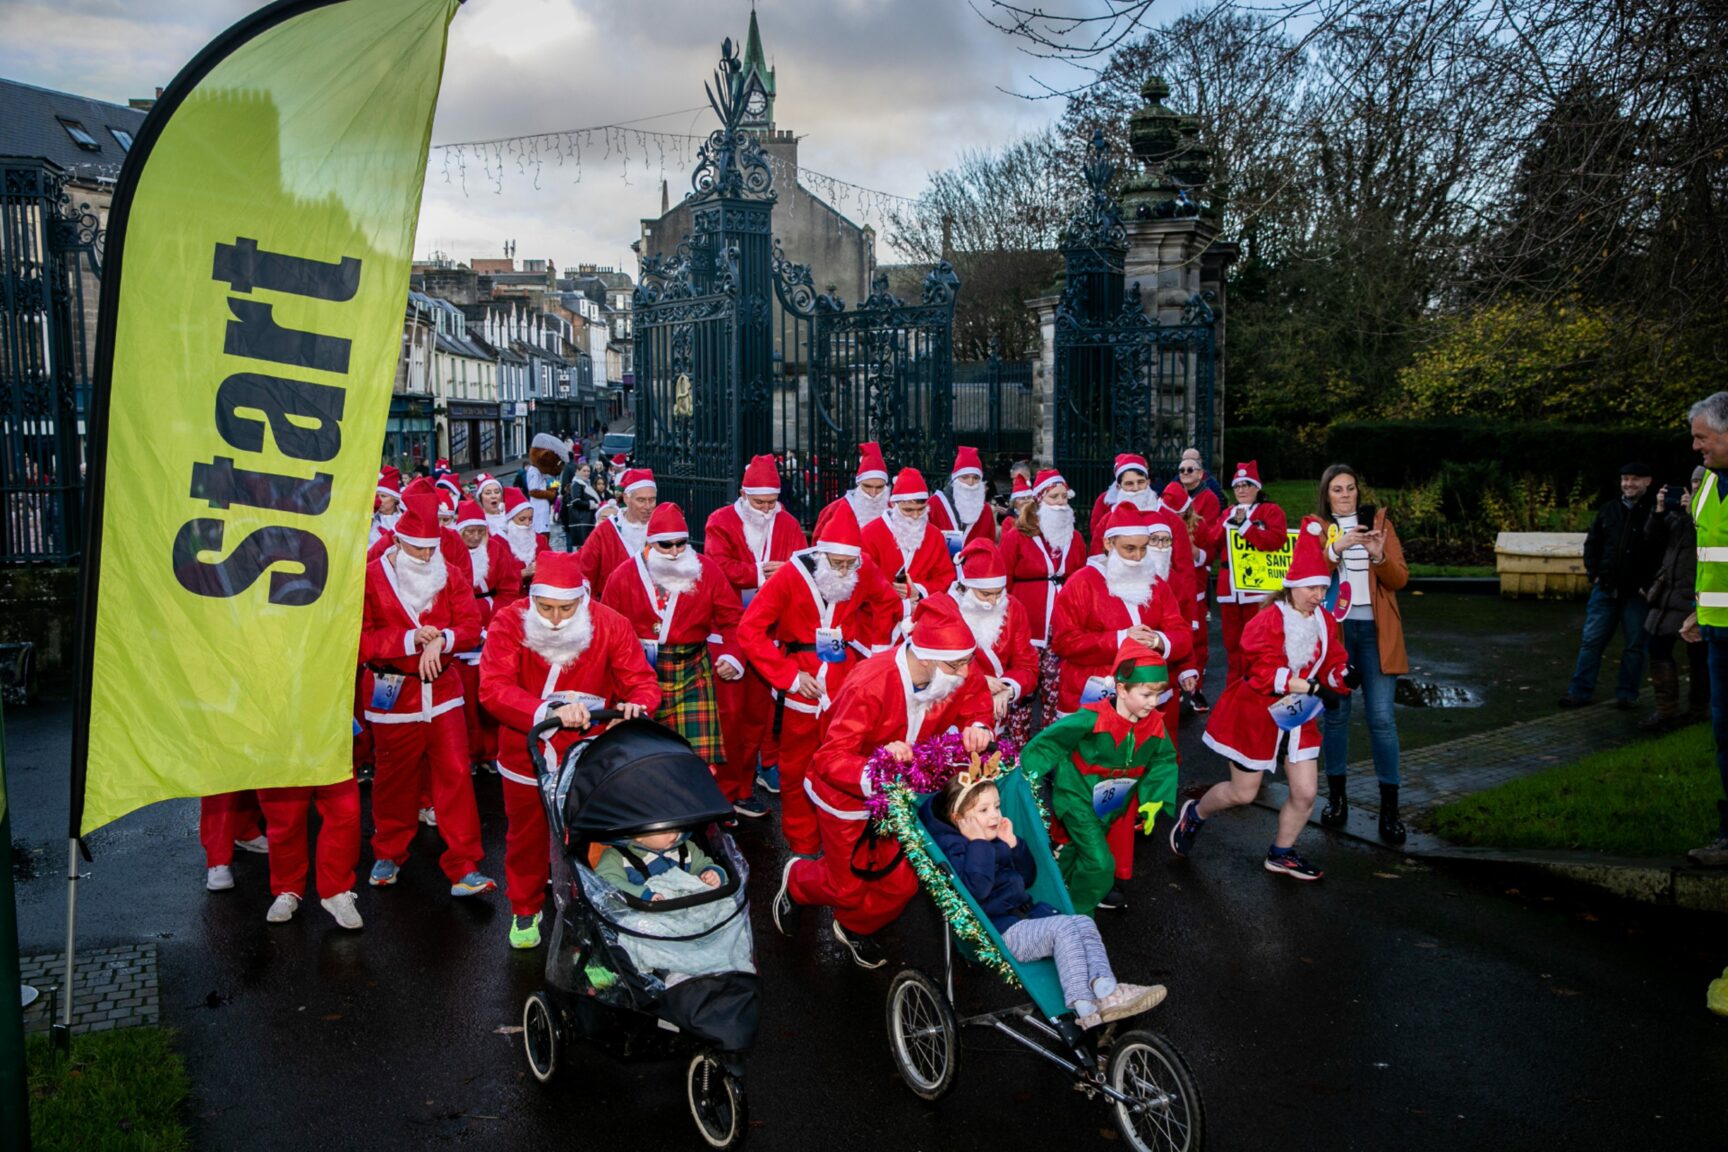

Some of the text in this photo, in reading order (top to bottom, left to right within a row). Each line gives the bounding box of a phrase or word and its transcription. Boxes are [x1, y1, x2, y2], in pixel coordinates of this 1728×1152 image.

[172, 236, 362, 607] Start
[1266, 554, 1292, 567] SANT
[1286, 699, 1303, 716] 37
[1101, 787, 1116, 804] 28
